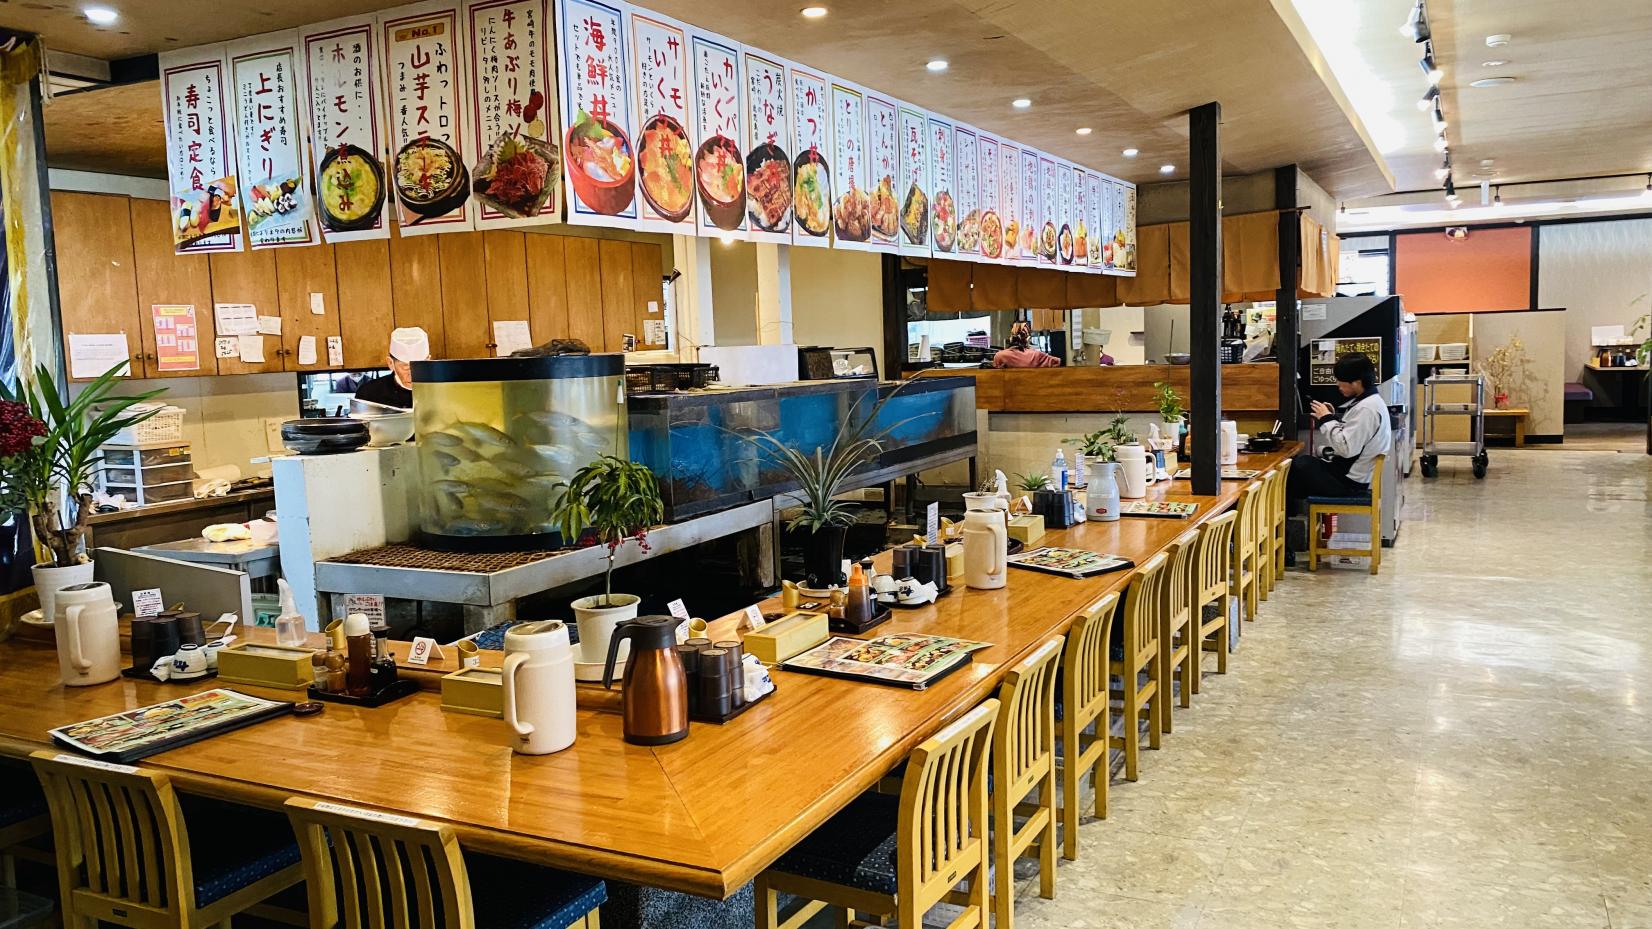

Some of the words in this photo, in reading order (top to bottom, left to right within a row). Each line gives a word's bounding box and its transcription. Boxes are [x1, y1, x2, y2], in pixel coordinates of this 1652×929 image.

[276, 62, 288, 146] 店長おすすめ寿司
[410, 45, 433, 192] 山芋ステーキ
[434, 42, 451, 142] ふわっトロっ
[583, 16, 611, 127] 海鮮丼
[805, 85, 820, 164] かつ丼
[185, 83, 204, 191] 寿司定食
[255, 72, 276, 180] 上にぎり
[331, 43, 354, 212] ホルモン煮込み
